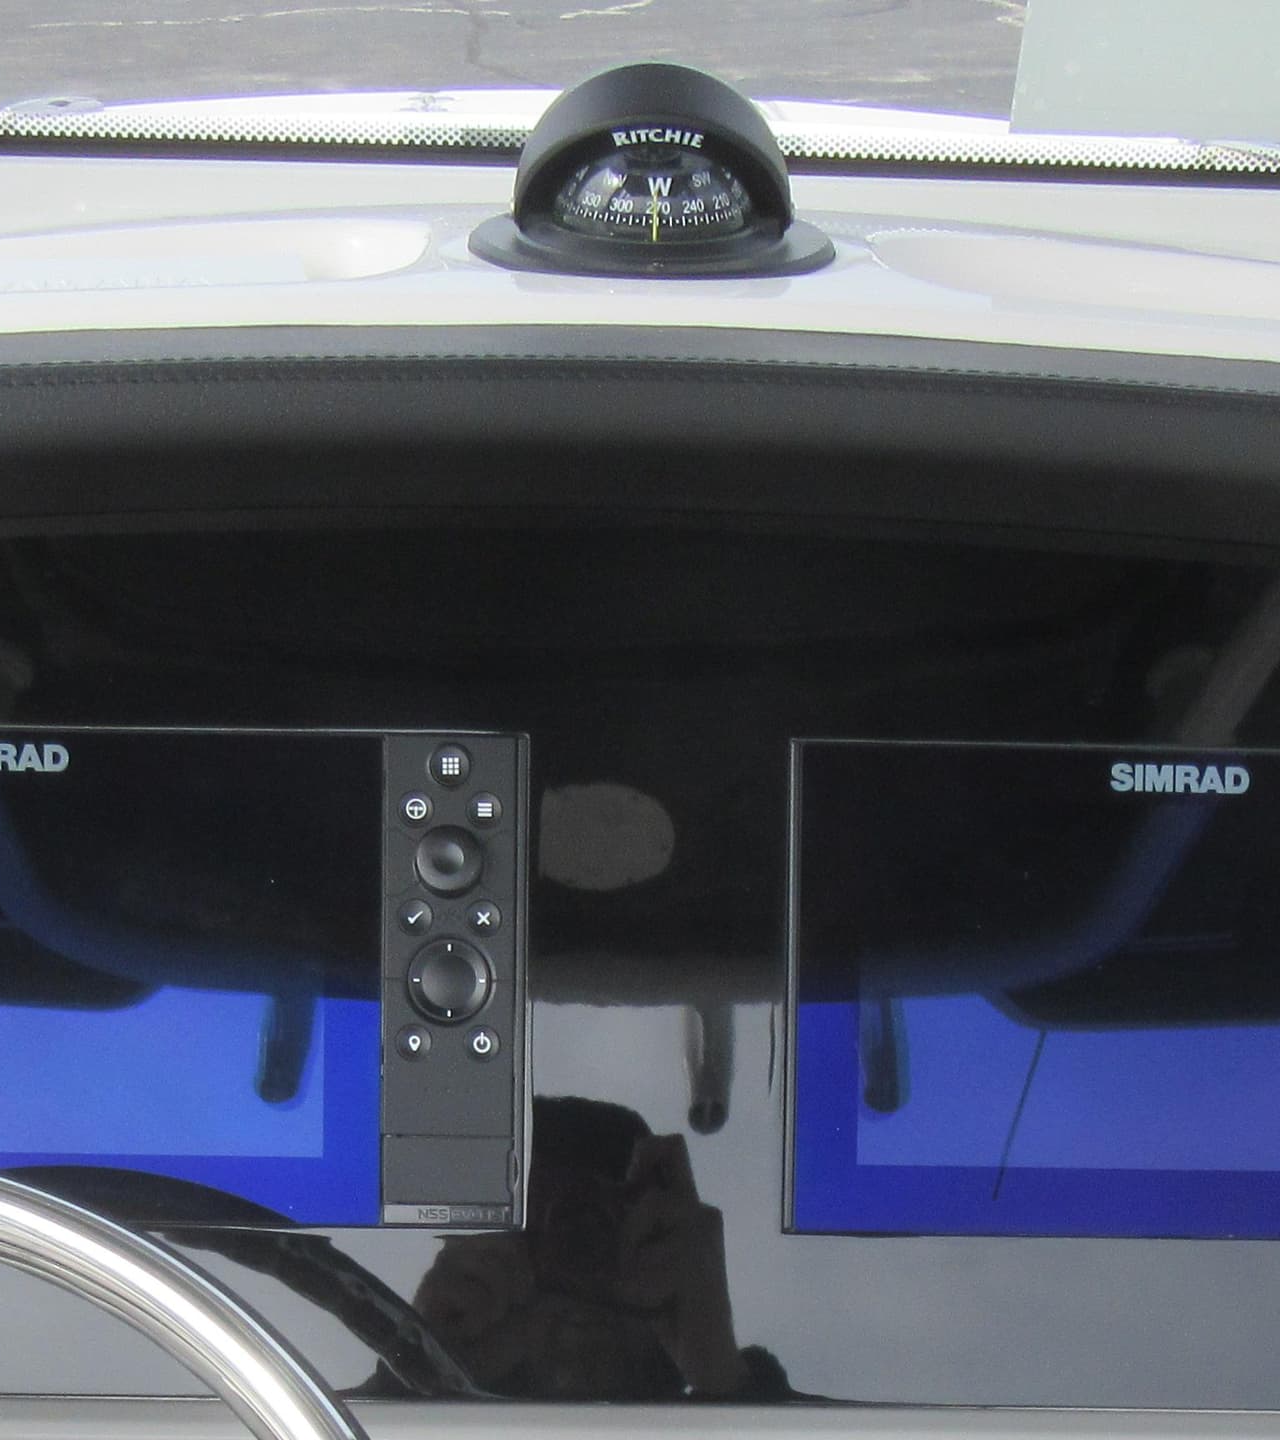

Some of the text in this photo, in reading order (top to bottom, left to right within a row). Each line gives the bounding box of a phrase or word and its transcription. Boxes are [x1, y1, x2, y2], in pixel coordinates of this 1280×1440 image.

[612, 128, 704, 148] RITCHIE
[648, 177, 672, 197] W
[609, 199, 634, 214] 300
[682, 199, 705, 214] 240
[712, 193, 730, 209] 210
[1110, 763, 1250, 794] SIMRAD
